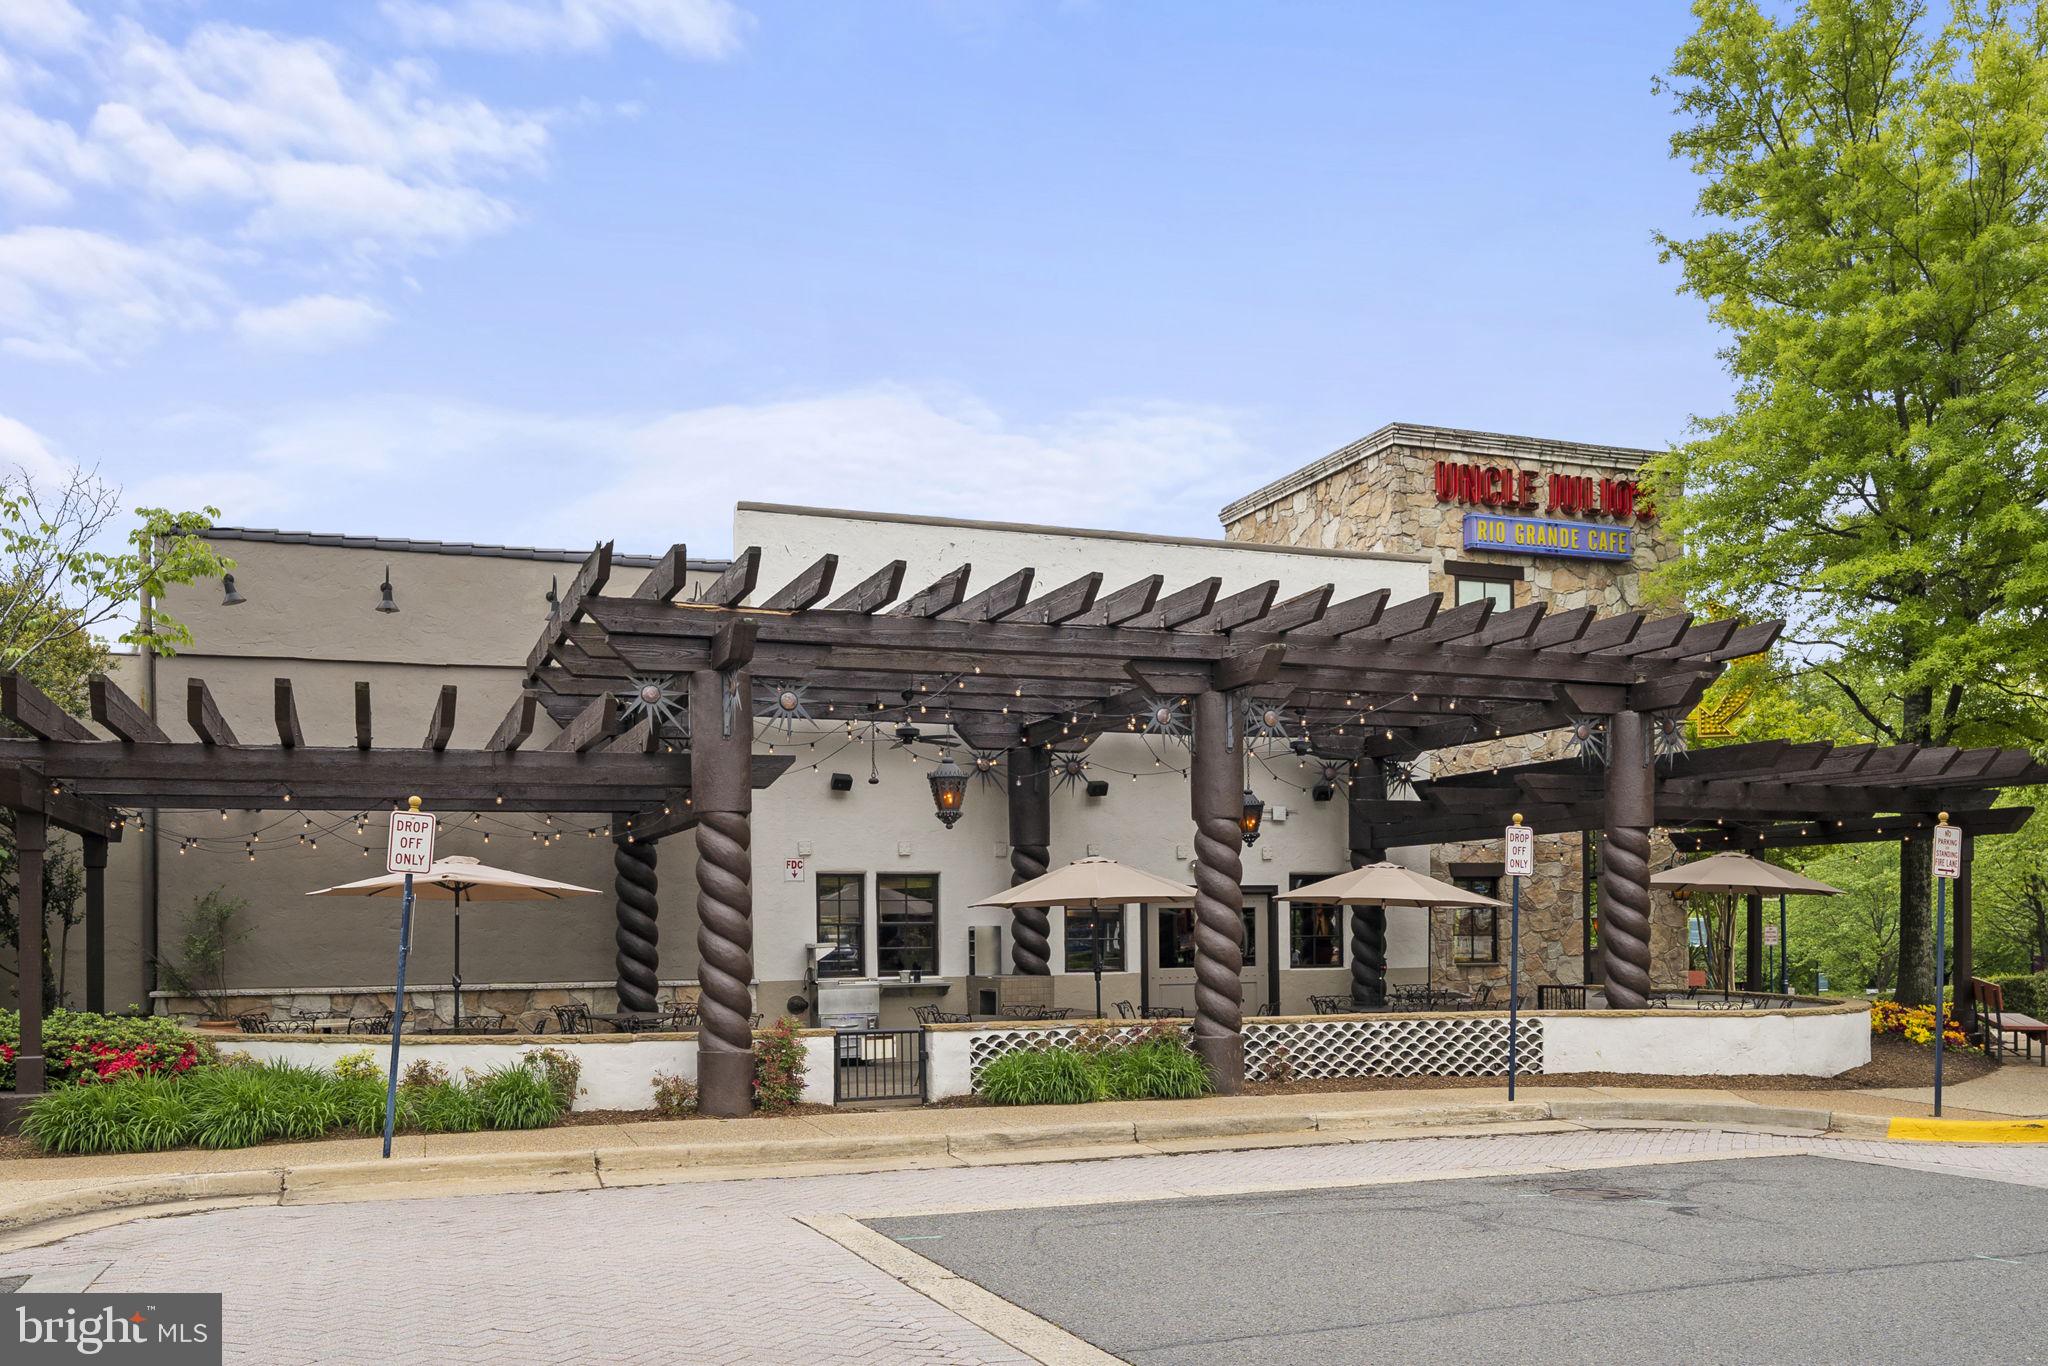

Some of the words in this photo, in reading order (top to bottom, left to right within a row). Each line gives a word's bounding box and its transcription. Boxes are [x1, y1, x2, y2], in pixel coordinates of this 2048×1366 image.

[1435, 461, 1539, 510] UNCLE
[1477, 520, 1505, 543] RIO
[1515, 524, 1579, 549] GRANDE
[1588, 529, 1627, 553] CAFE
[397, 820, 428, 833] DROP
[400, 836, 423, 849] OFF
[1509, 832, 1530, 843] DROP
[1938, 838, 1957, 846] PARKING
[1512, 846, 1527, 856] OFF
[1936, 850, 1958, 858] STANDING
[395, 853, 425, 866] ONLY
[786, 860, 803, 870] FDC
[1509, 858, 1529, 869] ONLY
[1935, 858, 1945, 867] FIRE
[1947, 859, 1957, 868] LANE
